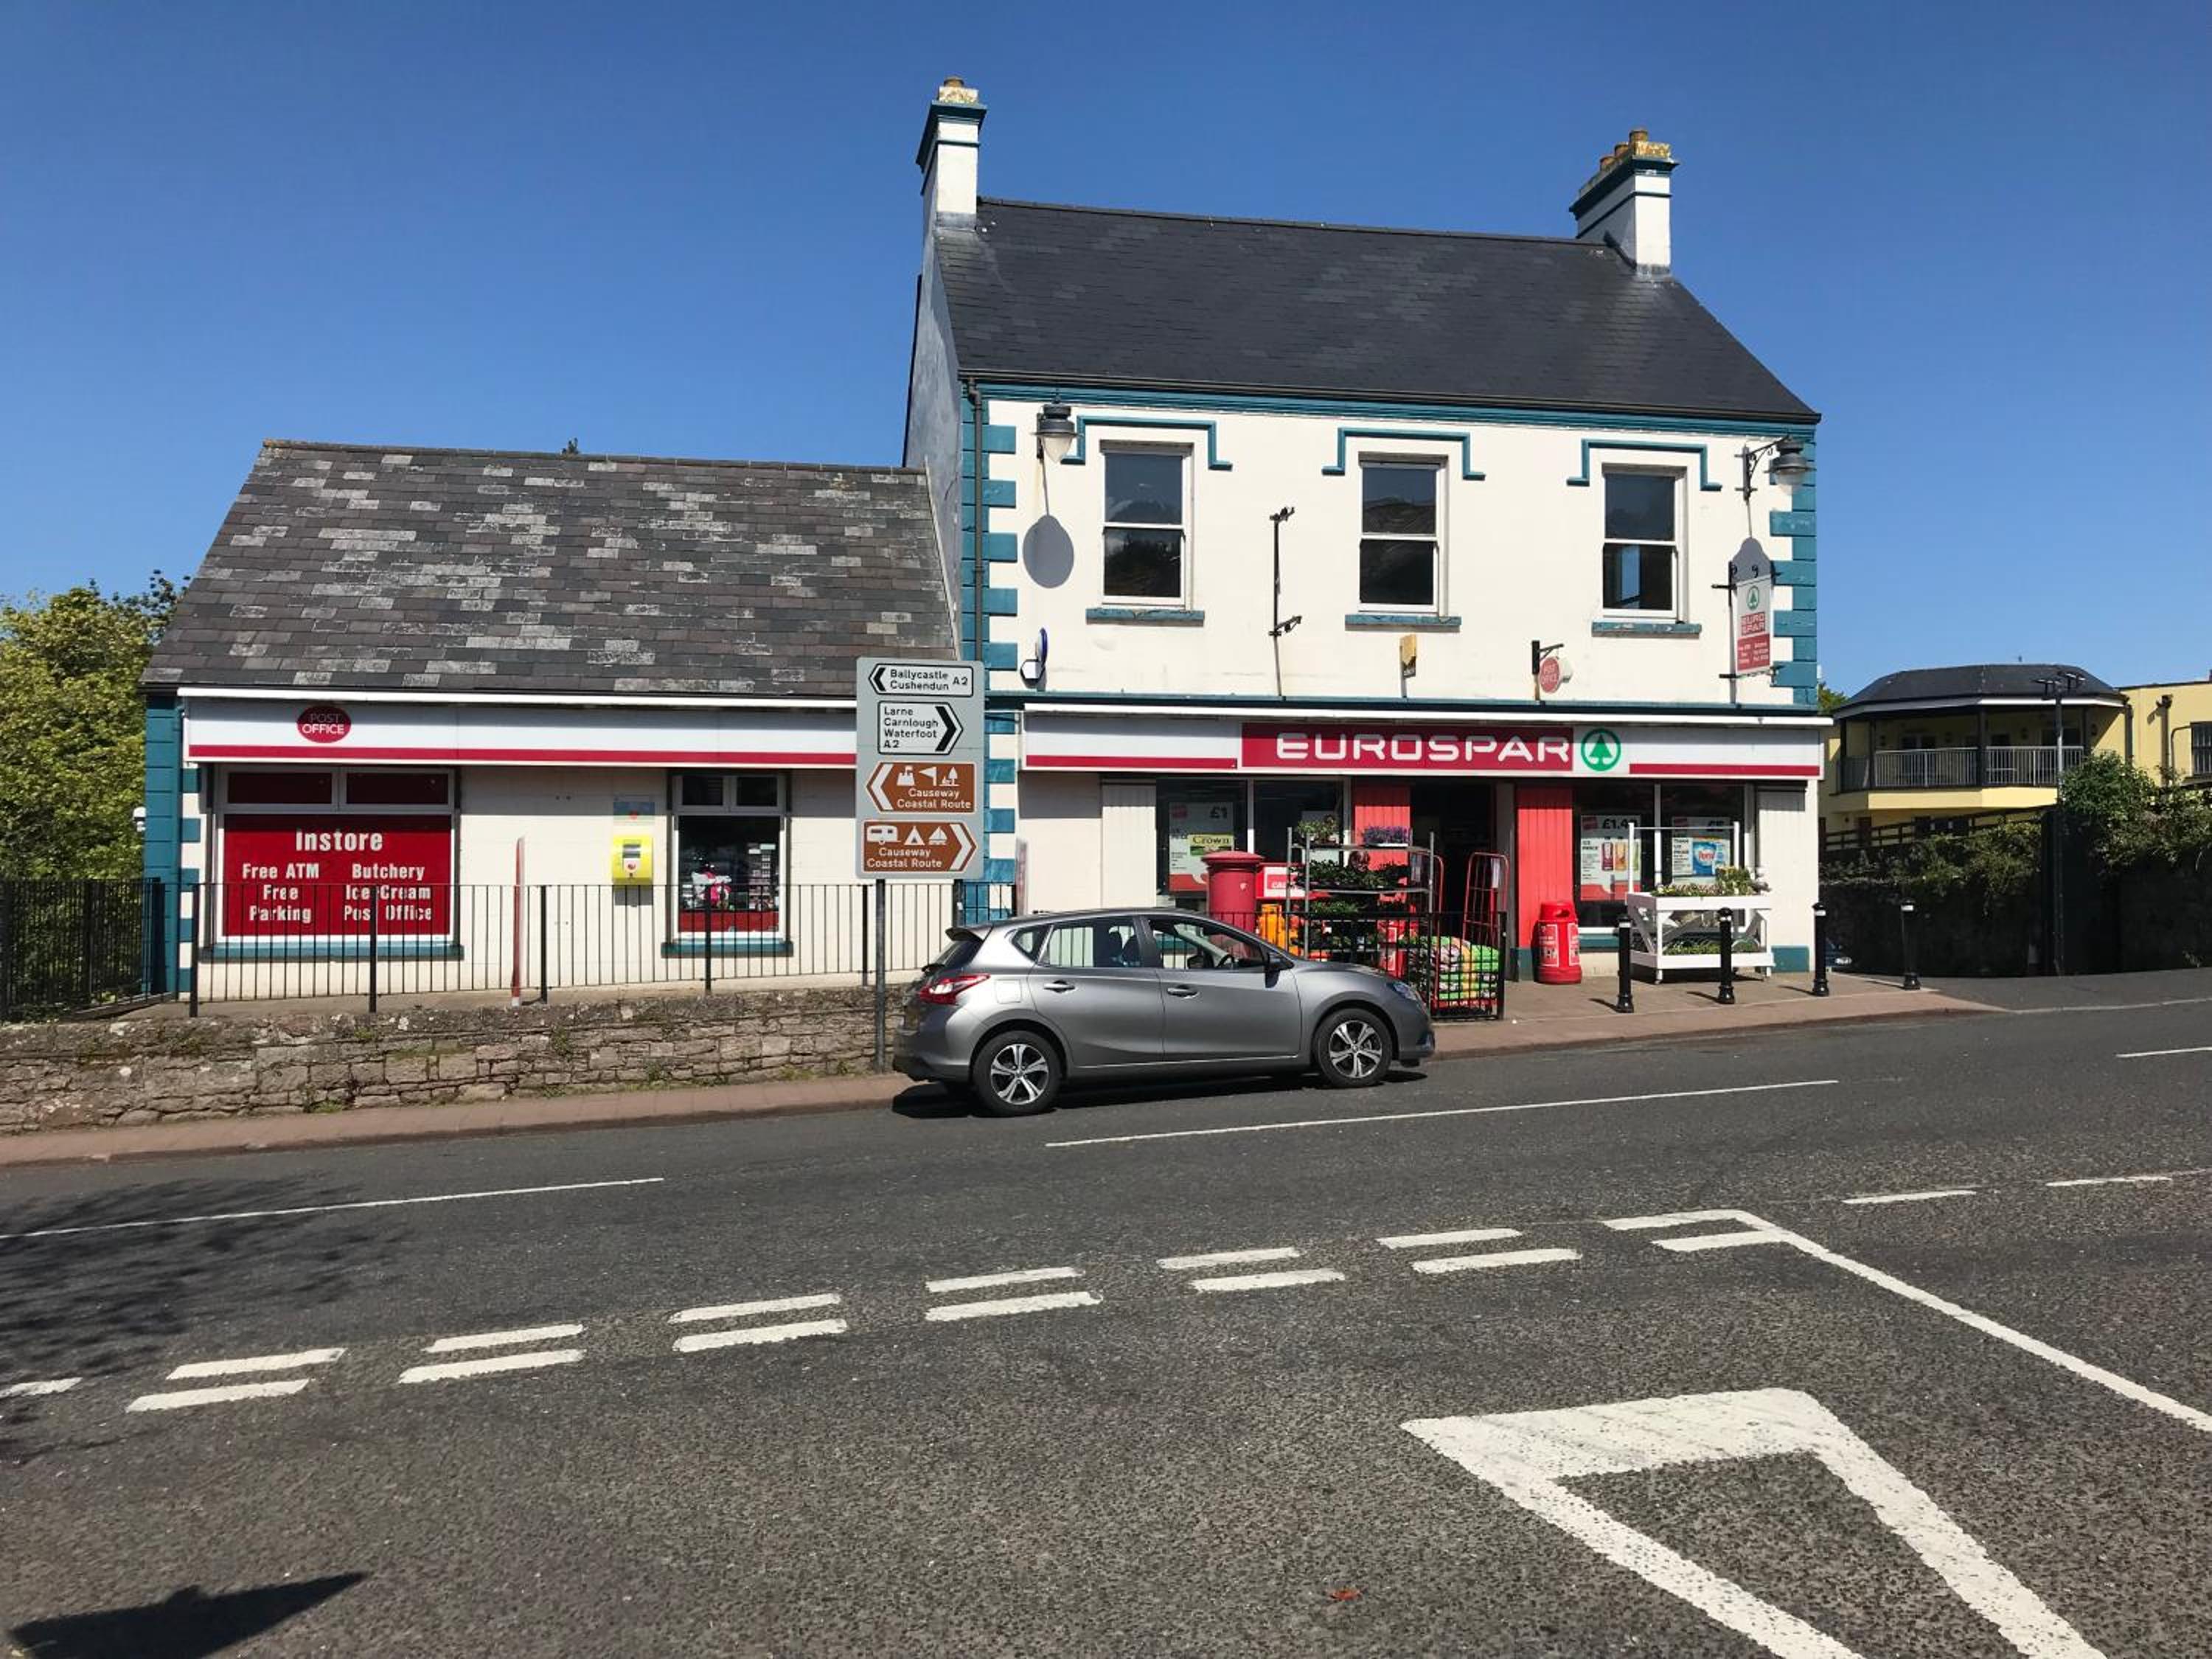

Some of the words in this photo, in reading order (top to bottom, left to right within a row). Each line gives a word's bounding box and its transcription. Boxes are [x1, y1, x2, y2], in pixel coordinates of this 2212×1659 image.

[890, 669, 948, 680] Ballycastle
[953, 676, 969, 686] A2
[890, 680, 949, 690] Cushendun
[884, 706, 914, 715] Larne
[310, 713, 341, 723] POST
[884, 717, 939, 729] Carnlough
[302, 723, 344, 734] OFFICE
[884, 728, 937, 738] Waterfoot
[884, 740, 900, 748] A2
[1276, 733, 1570, 762] EUROSPAR
[908, 788, 960, 799] Causeway
[897, 799, 937, 808] Coastal
[940, 799, 972, 809] Route
[296, 831, 383, 852] Instore
[1192, 835, 1230, 844] Crown
[878, 847, 931, 858] Causeway
[866, 858, 908, 868] Coastal
[911, 858, 942, 868] Route
[243, 863, 278, 879] Free
[285, 863, 319, 879] ATM
[352, 863, 425, 881] Butchery
[263, 885, 299, 900] Free
[249, 905, 312, 924] Parking
[344, 905, 372, 921] Pos
[386, 905, 431, 921] Office
